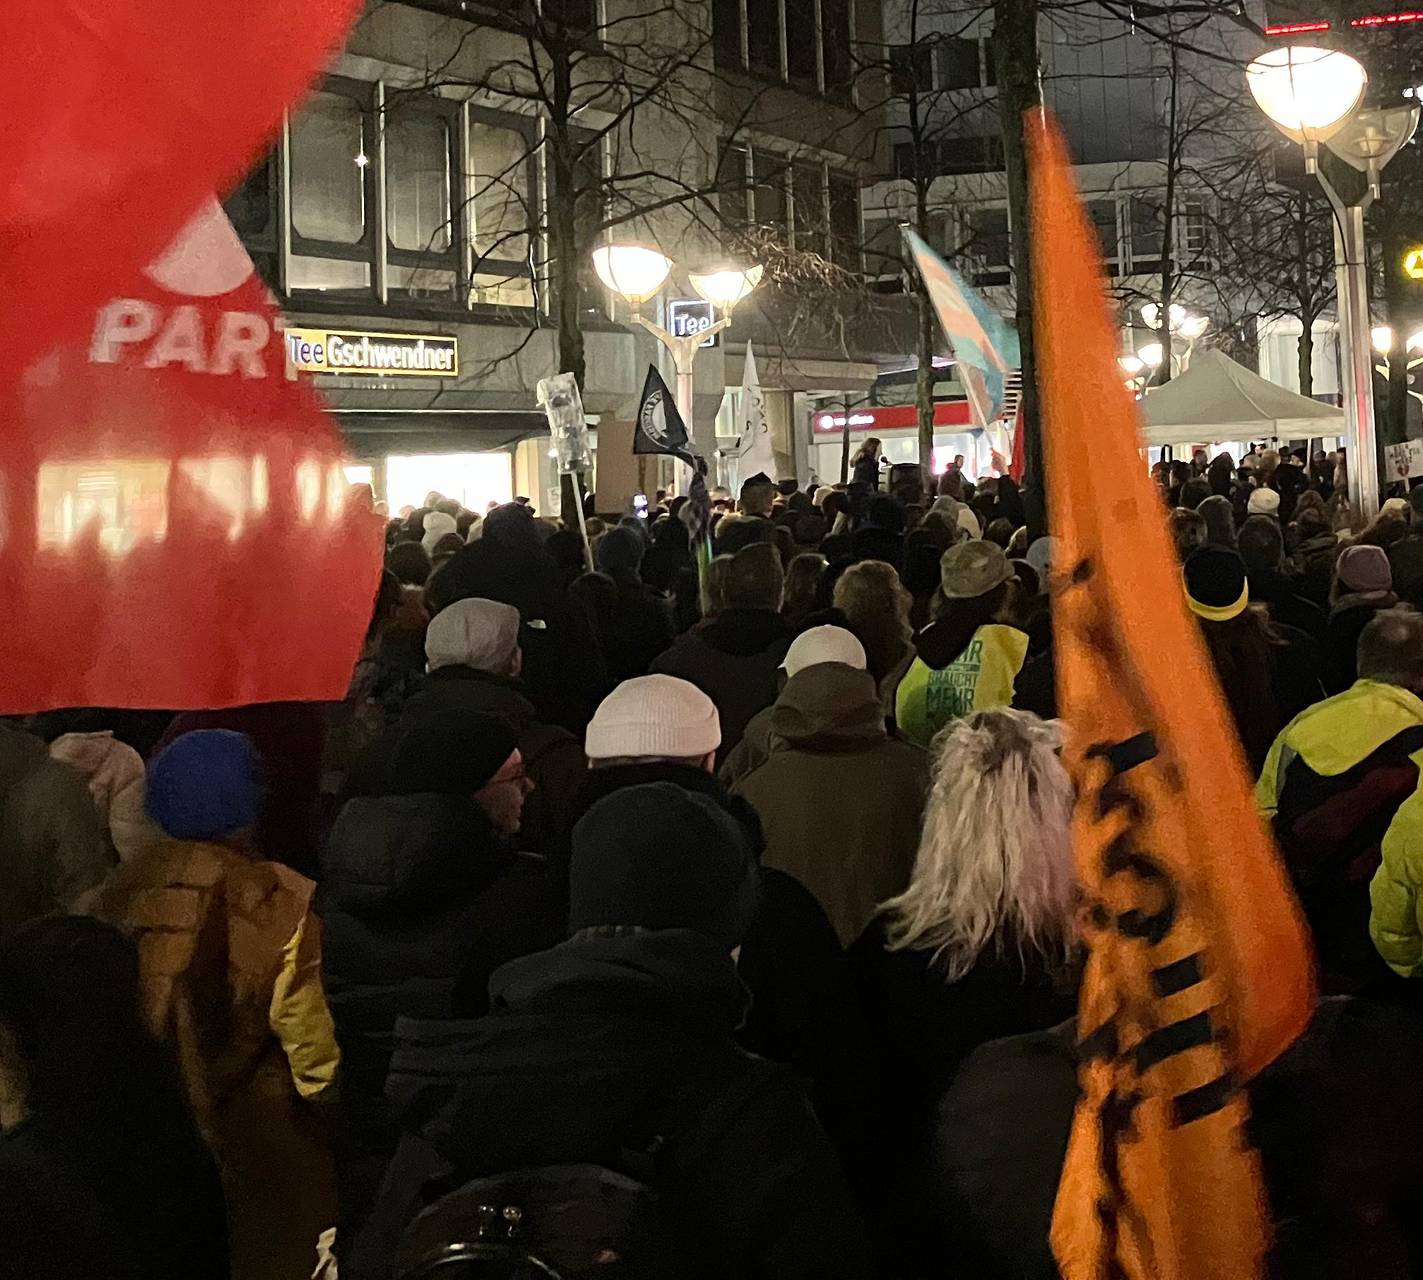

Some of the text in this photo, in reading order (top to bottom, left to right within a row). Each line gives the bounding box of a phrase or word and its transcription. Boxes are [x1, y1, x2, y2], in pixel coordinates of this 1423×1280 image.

[674, 313, 710, 335] Tee
[287, 334, 454, 370] Tee Gschwendner
[926, 686, 975, 714] MEHR
